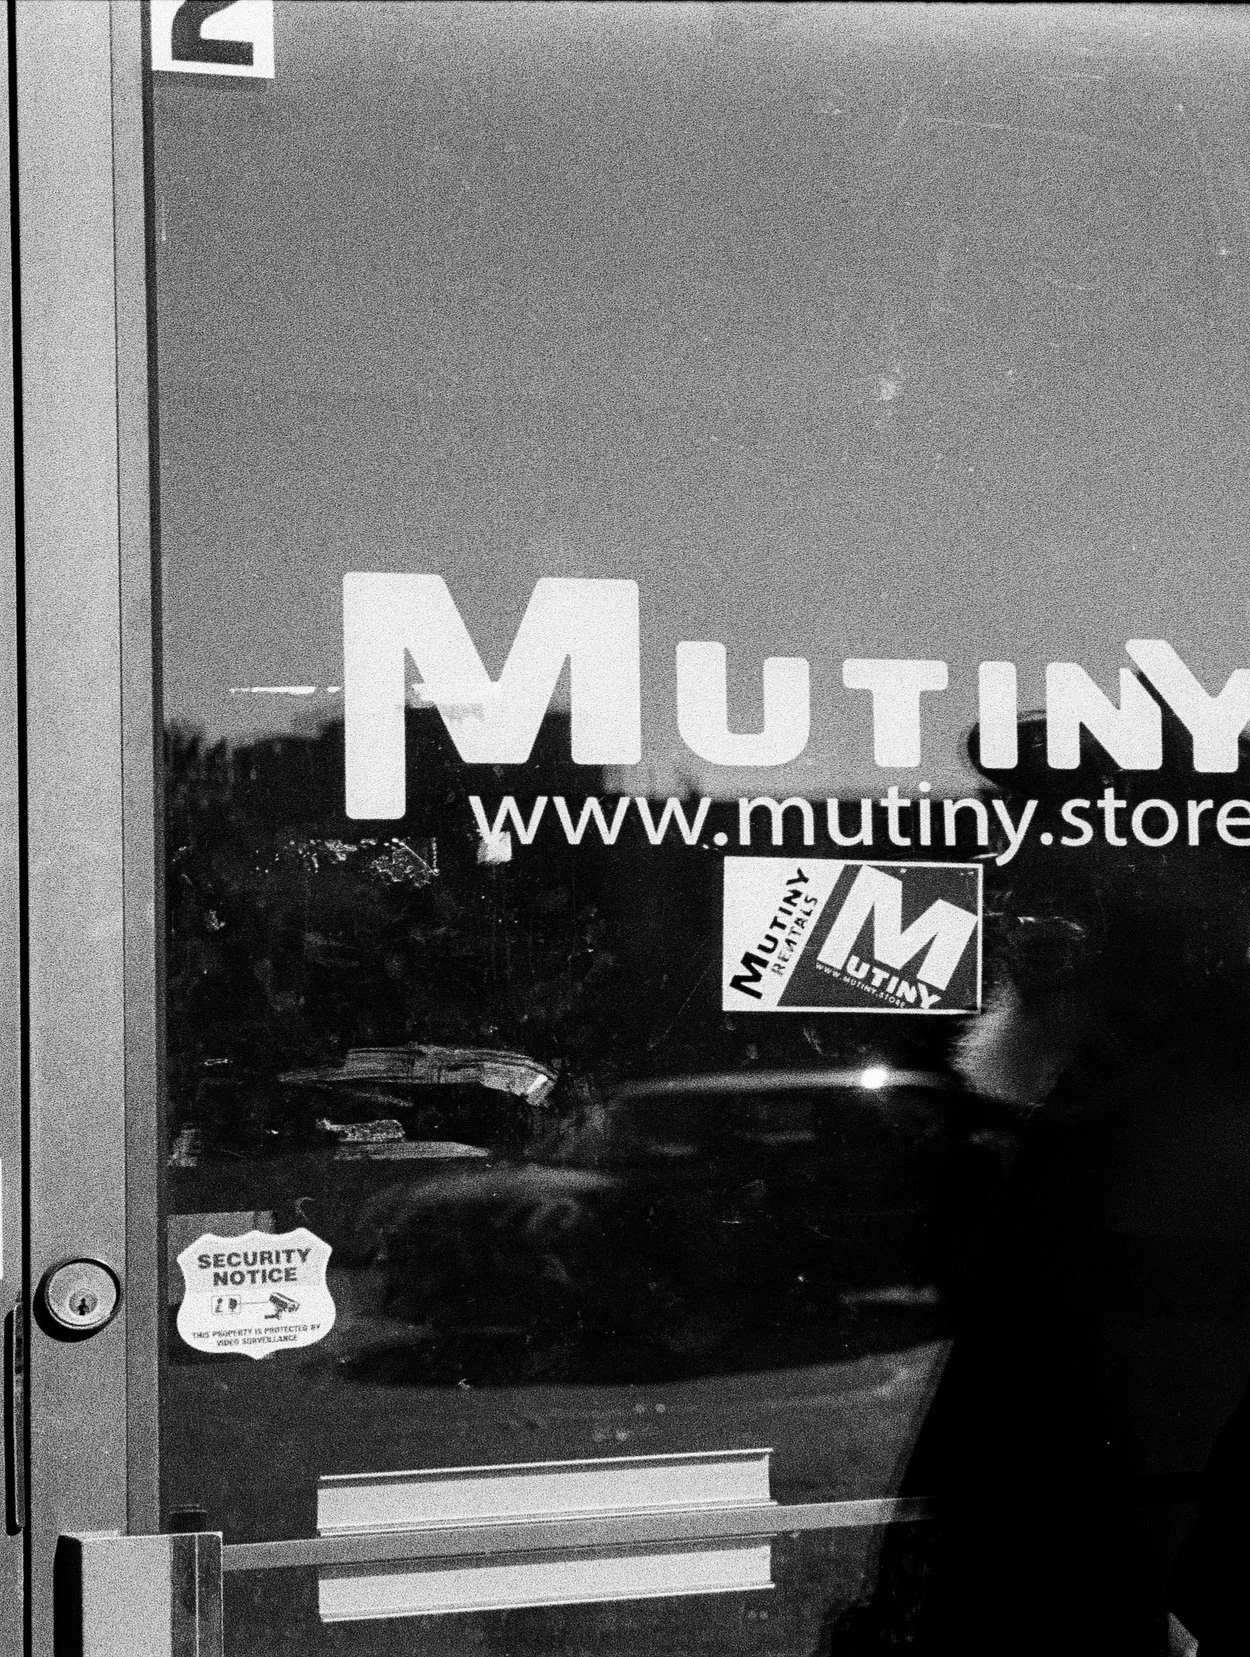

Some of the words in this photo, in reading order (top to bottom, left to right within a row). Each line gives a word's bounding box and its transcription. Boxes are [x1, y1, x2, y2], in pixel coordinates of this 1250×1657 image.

[729, 868, 809, 999] MUTINY
[197, 1248, 311, 1269] SECURITY
[213, 1267, 298, 1286] NOTICE
[193, 1331, 210, 1339] THIS
[212, 1328, 253, 1338] PROPERTY
[264, 1324, 308, 1334] PROTECTED
[216, 1338, 240, 1347] VIDEO
